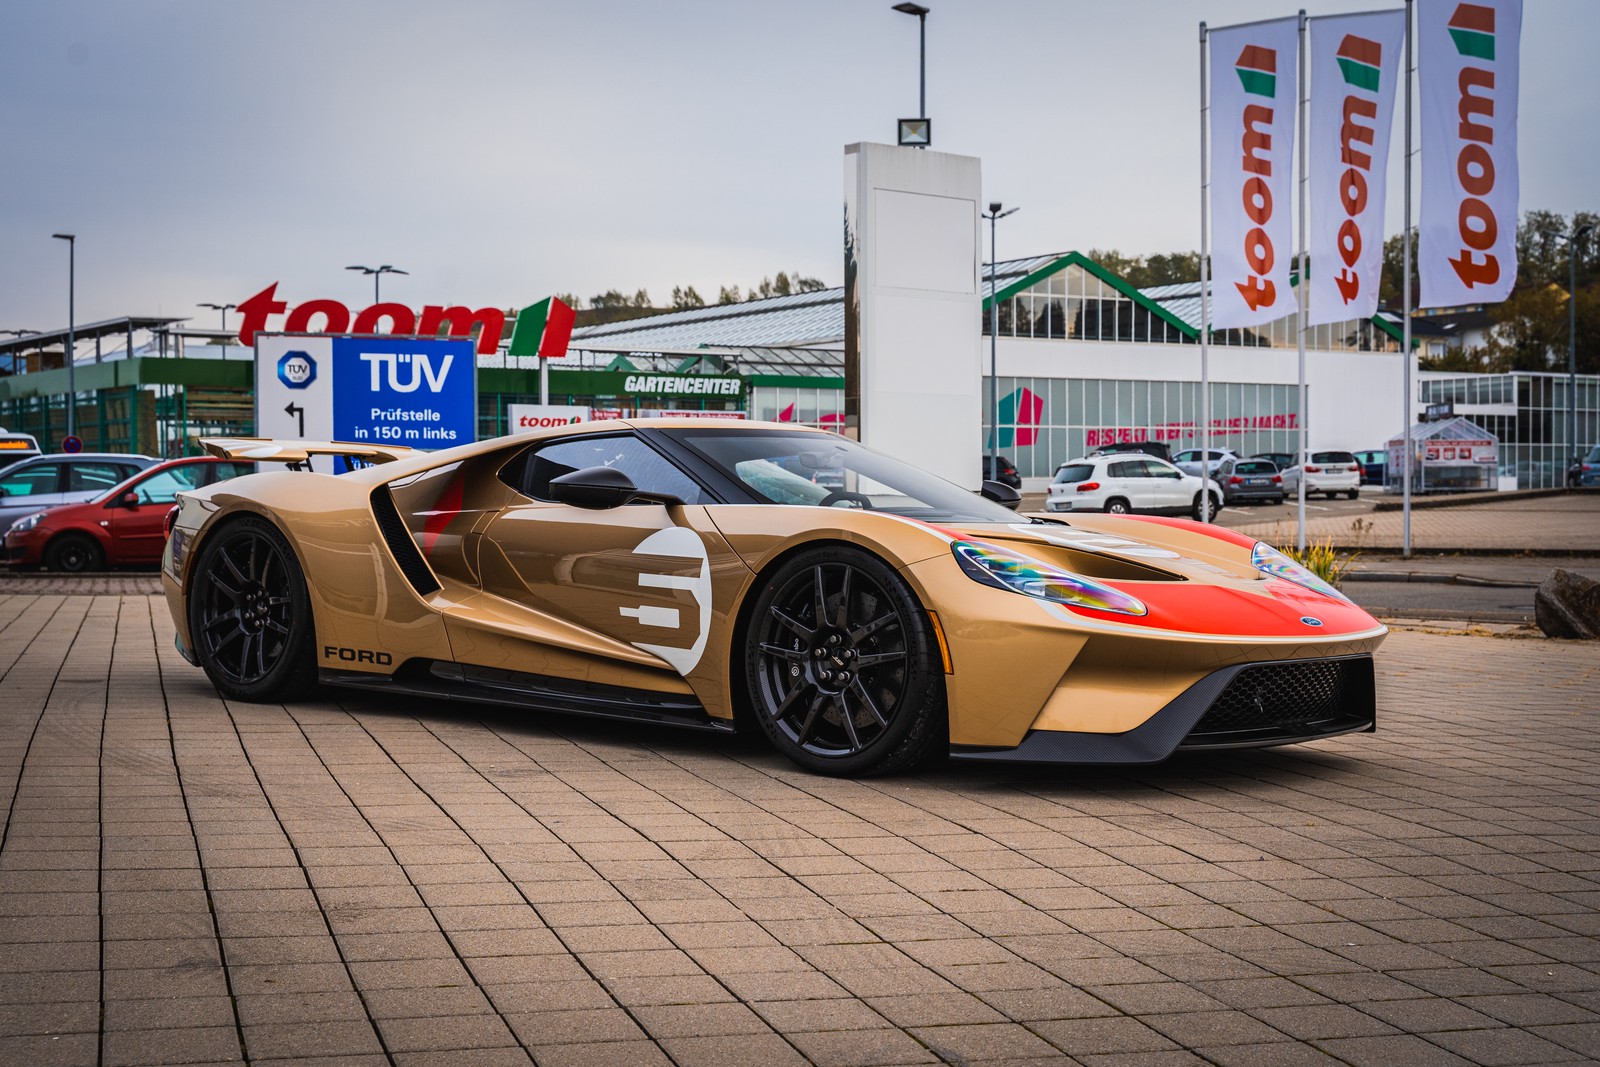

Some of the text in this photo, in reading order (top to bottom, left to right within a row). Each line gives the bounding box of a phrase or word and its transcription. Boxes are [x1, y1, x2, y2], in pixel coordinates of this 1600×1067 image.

[1448, 66, 1501, 290] toom
[1234, 103, 1277, 312] toom
[1334, 95, 1377, 306] toom
[235, 281, 505, 355] toom
[359, 352, 455, 393] TÜV
[624, 375, 742, 395] GARTENCENTER
[371, 408, 441, 421] Prüfstelle
[519, 415, 568, 428] toom
[355, 426, 458, 440] in 150 m links
[324, 646, 393, 666] FORD
